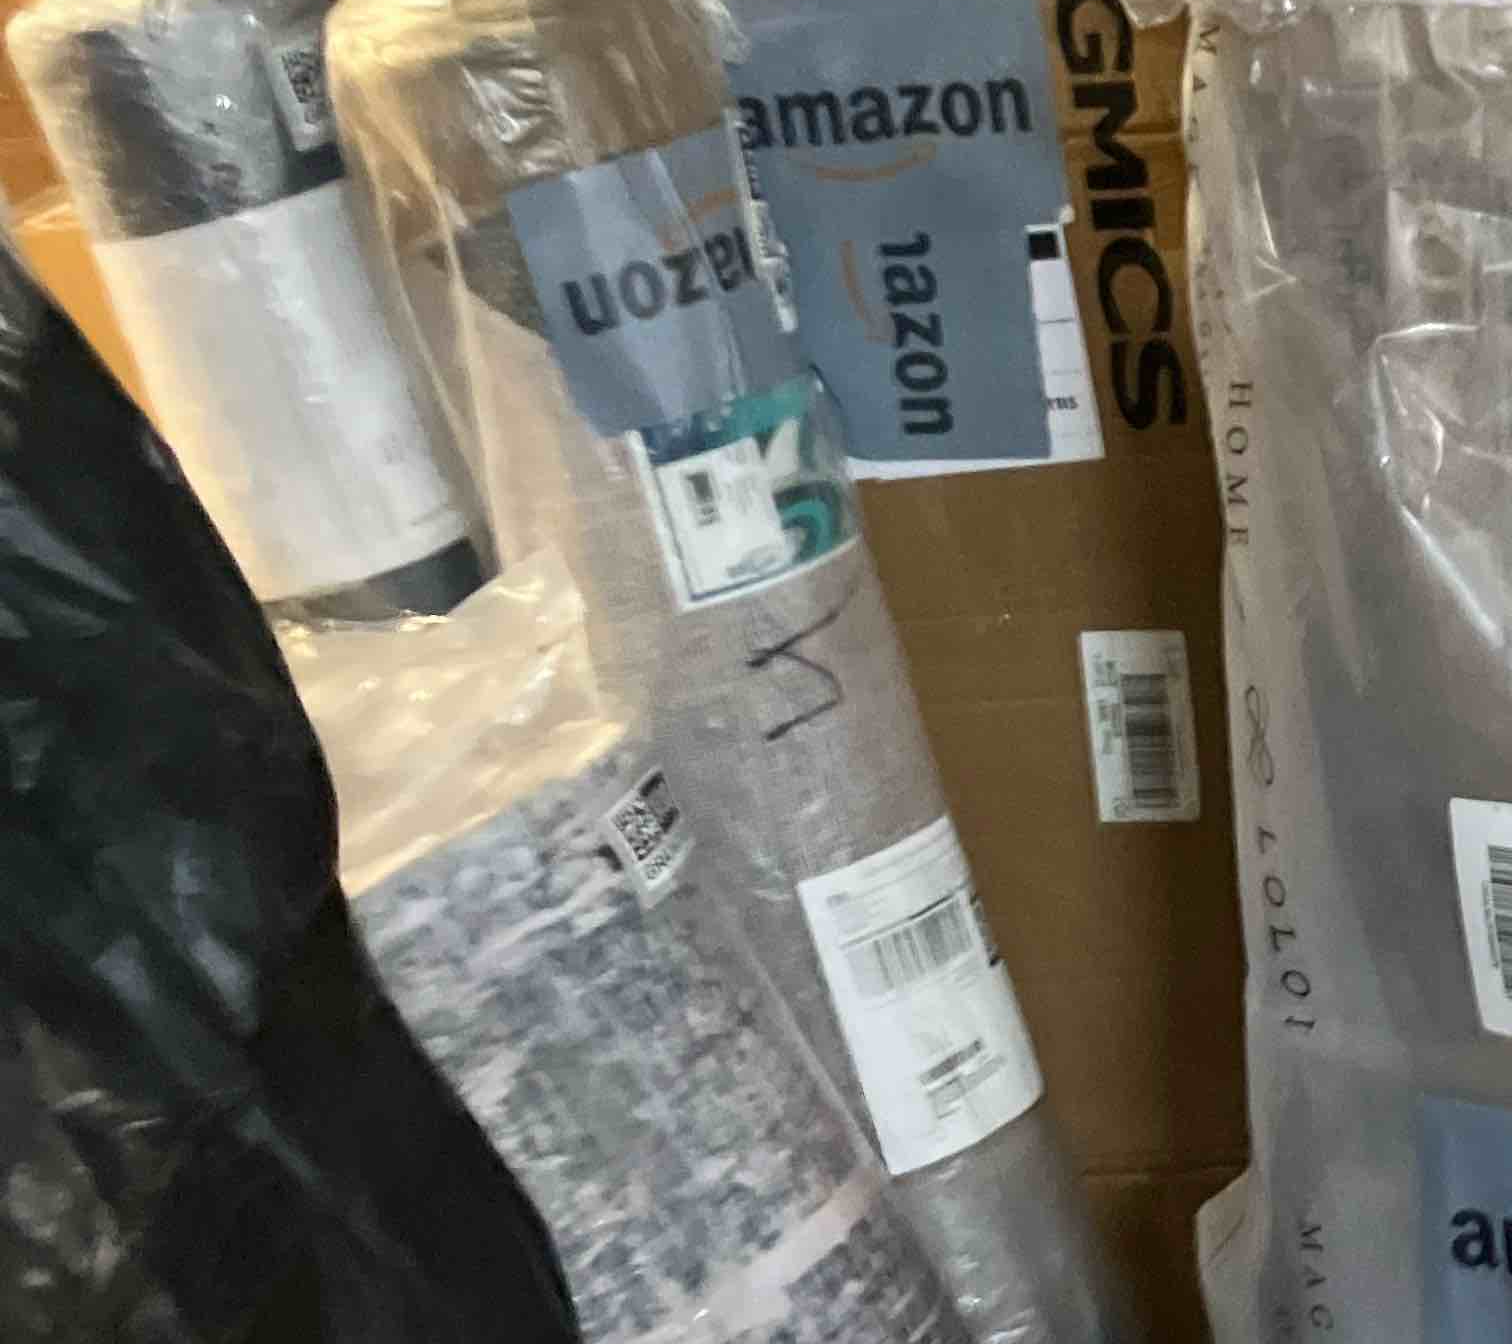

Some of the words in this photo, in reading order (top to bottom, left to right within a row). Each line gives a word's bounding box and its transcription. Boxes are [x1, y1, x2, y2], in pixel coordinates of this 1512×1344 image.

[738, 75, 1033, 151] amazon
[560, 226, 757, 336] azon
[877, 230, 954, 436] azon
[1225, 378, 1254, 546] HOME
[1256, 824, 1316, 1034] LOLOI
